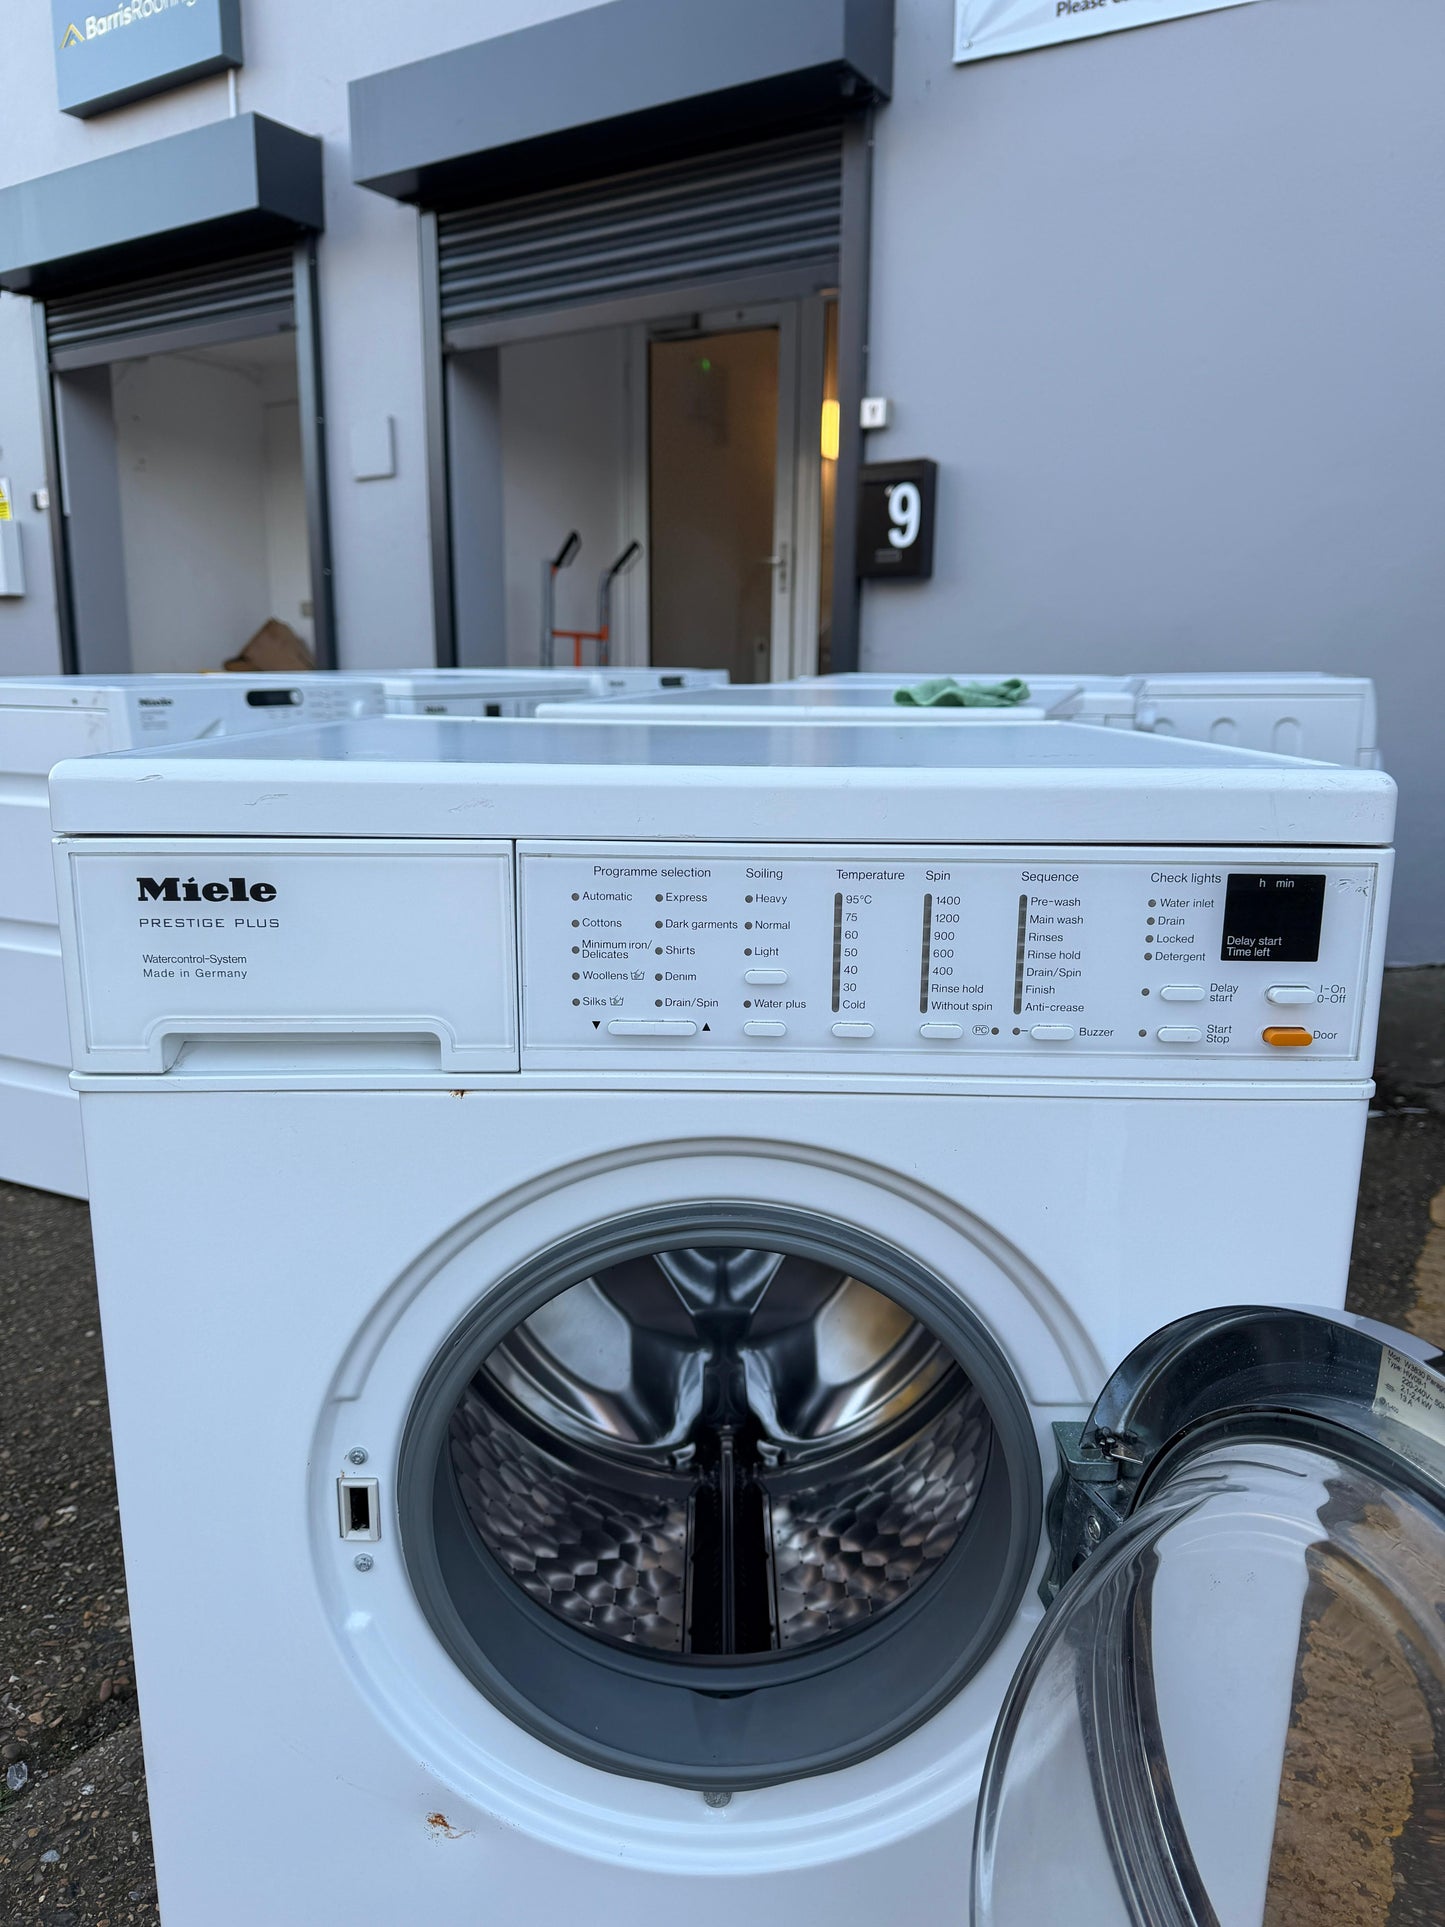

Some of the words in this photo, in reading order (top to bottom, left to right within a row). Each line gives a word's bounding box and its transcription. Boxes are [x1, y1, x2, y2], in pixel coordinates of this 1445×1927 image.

[1056, 0, 1105, 17] Please
[888, 481, 921, 549] 9
[594, 866, 657, 878] Programme
[661, 867, 711, 877] selection
[746, 868, 783, 880] Soiling
[836, 869, 904, 881] Temperature
[926, 870, 950, 882] Spin
[1022, 871, 1079, 883] Sequence
[1151, 872, 1187, 882] Check
[1191, 873, 1221, 885] lights
[1259, 878, 1265, 887] h
[1276, 879, 1294, 887] min
[137, 877, 276, 902] Miele
[583, 892, 632, 901] Automatic
[666, 893, 707, 903] Express
[756, 894, 787, 904] Heavy
[846, 895, 872, 904] 95°C
[937, 896, 960, 905] 1400
[1031, 897, 1080, 906] Pre-wash
[1160, 898, 1190, 907] Water
[1193, 899, 1214, 908] inlet
[846, 913, 857, 921] 75
[936, 914, 959, 923] 1200
[1030, 915, 1053, 924] Main
[1057, 916, 1083, 924] wash
[1158, 916, 1184, 925] Drain
[140, 919, 224, 927] PRESTIGE
[235, 919, 279, 928] PLUS
[582, 918, 622, 927] Cottons
[666, 919, 689, 928] Dark
[692, 921, 738, 930] garments
[755, 921, 790, 929] Normal
[845, 931, 858, 939] 60
[934, 932, 954, 940] 900
[1029, 933, 1063, 942] Rinses
[1157, 934, 1194, 943] Locked
[582, 940, 626, 950] Minimum
[629, 940, 652, 949] iron/
[1227, 936, 1256, 946] Delay
[1258, 937, 1282, 945] start
[582, 950, 628, 959] Delicates
[666, 946, 695, 955] Shirts
[755, 947, 778, 957] Light
[844, 948, 857, 957] 50
[933, 949, 954, 958] 600
[1028, 950, 1054, 959] Rinse
[1058, 951, 1080, 959] hold
[1227, 948, 1252, 956] Time
[1254, 947, 1270, 956] left
[143, 954, 246, 965] Watercontrol-System
[1156, 952, 1205, 962] Detergent
[144, 969, 174, 977] Made
[180, 969, 189, 977] in
[195, 969, 247, 979] Germany
[844, 966, 858, 974] 40
[933, 967, 953, 975] 400
[1027, 968, 1081, 978] Drain/Spin
[583, 971, 628, 980] Woollens
[665, 972, 696, 980] Denim
[843, 983, 856, 991] 30
[932, 984, 959, 993] Rinse
[963, 985, 983, 993] hold
[1026, 985, 1055, 994] Finish
[1210, 983, 1238, 993] Delay
[583, 997, 606, 1006] Silks
[1210, 994, 1233, 1002] start
[1317, 994, 1346, 1003] 0-Off
[665, 998, 718, 1008] Drain/Spin
[754, 999, 782, 1008] Water
[786, 1000, 806, 1009] plus
[843, 1000, 865, 1009] Cold
[932, 1001, 969, 1010] Without
[972, 1002, 992, 1012] spin
[1025, 1003, 1084, 1012] Anti-crease
[974, 1026, 988, 1034] PC
[1080, 1027, 1114, 1036] Buzzer
[1207, 1024, 1232, 1034] Start
[1206, 1034, 1229, 1044] Stop
[1312, 1031, 1338, 1040] Door
